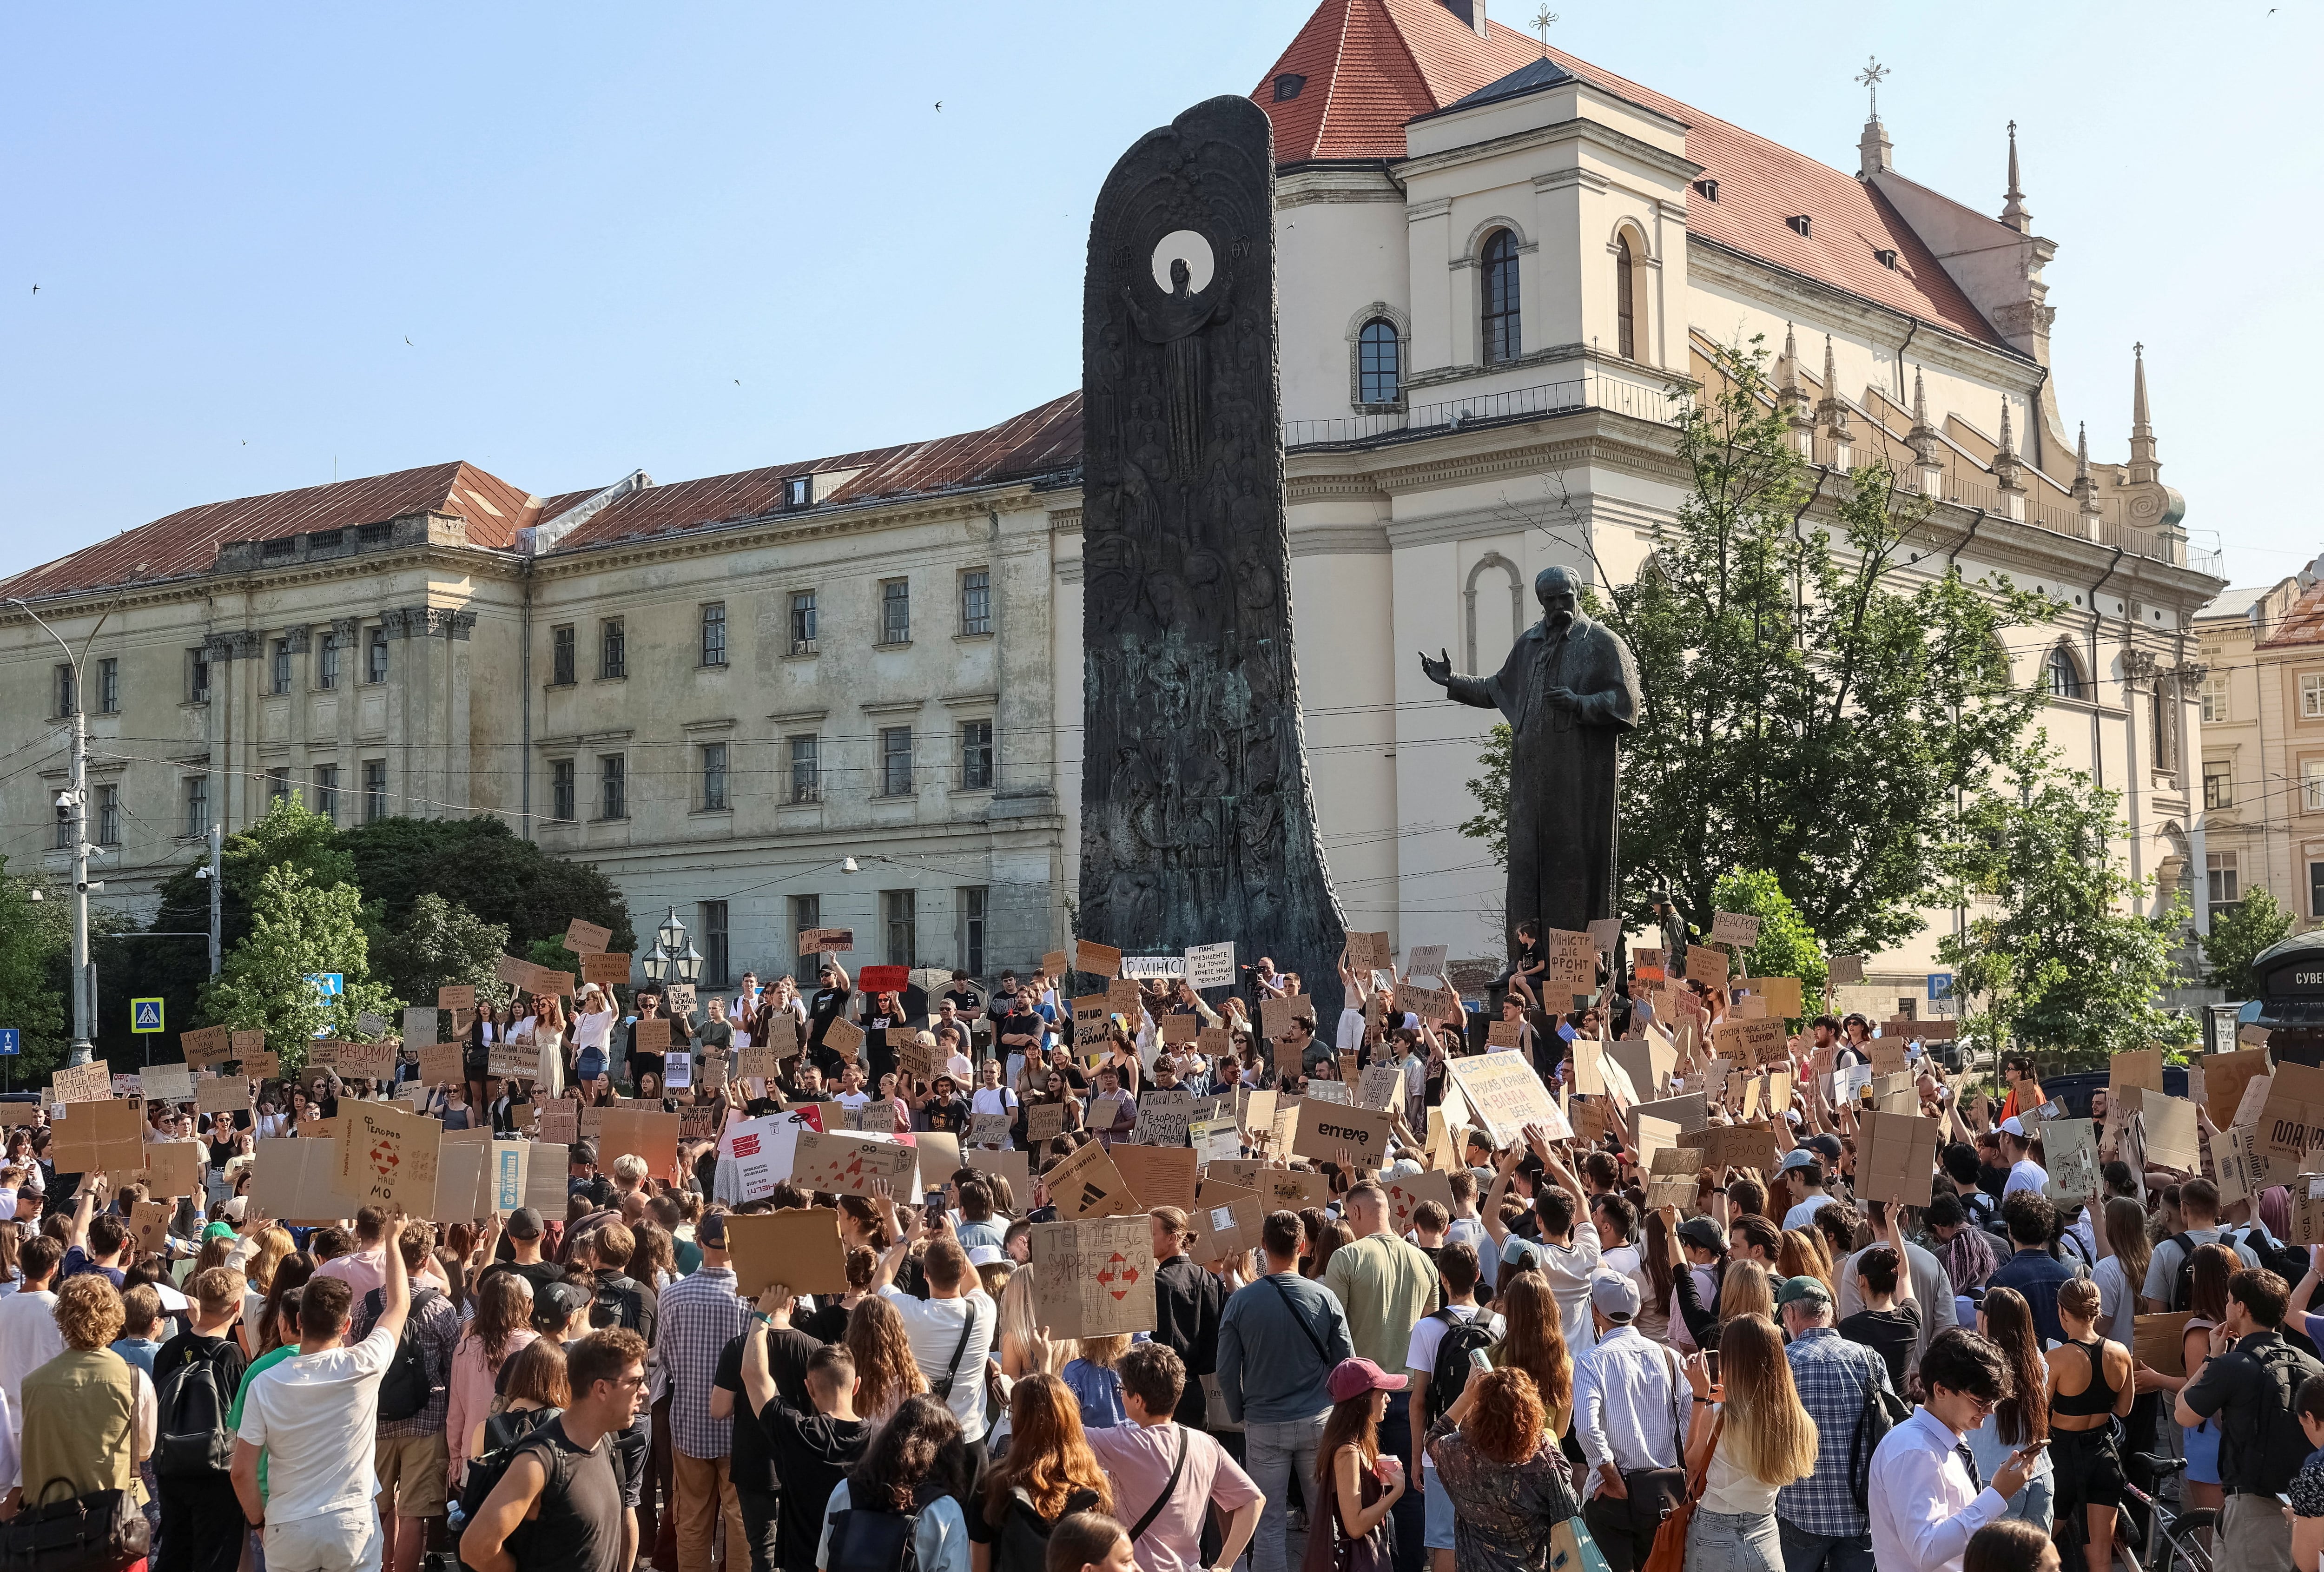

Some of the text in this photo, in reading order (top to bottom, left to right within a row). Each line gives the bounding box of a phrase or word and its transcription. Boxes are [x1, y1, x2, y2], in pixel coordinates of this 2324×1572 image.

[1374, 944, 1385, 955] НЕ
[1191, 951, 1229, 962] ПРЕЗИДЕНТЕ,
[1351, 955, 1379, 967] ПОРАДИВ
[1216, 965, 1233, 974] НАШОЇ
[1551, 957, 1589, 971] ФРОНТ
[1198, 973, 1230, 984] ПЕРЕМОГИ?
[1399, 984, 1430, 1000] РЕФОРМА
[1402, 996, 1445, 1017] МАЄ ЖИТИ
[362, 1013, 387, 1026] ФЕДОРОВ
[1078, 1008, 1102, 1021] ВИ ШО
[771, 1018, 793, 1033] БІГОМ
[835, 1018, 859, 1037] ПОКАЖІТЬ
[1075, 1026, 1093, 1038] ЙОБУ
[1494, 1023, 1519, 1034] ЕПОХА
[1884, 1024, 1921, 1037] ПОВЕРНІТЬ
[234, 1030, 262, 1046] СЕБЕ
[774, 1032, 794, 1044] ВЕРНУВ
[1720, 1026, 1740, 1040] РУСНЯ
[189, 1047, 214, 1056] МІНІСТР
[202, 1047, 228, 1057] ОБОРОНИ
[340, 1043, 392, 1062] РЕФОРМИ
[491, 1043, 518, 1054] ЗАГАЛЬНА
[739, 1048, 766, 1057] ФЕДОРОВ
[901, 1038, 928, 1059] ВЕРНІТЬ
[743, 1063, 764, 1074] НАДІЯ
[901, 1052, 931, 1076] ФЕДОРОВА
[54, 1066, 86, 1082] ЛИПЕНЬ
[513, 1066, 538, 1076] ФЕДОРОВ
[56, 1076, 87, 1091] МІСЯЦЬ
[1364, 1079, 1391, 1094] НАШОГО
[1172, 1093, 1184, 1105] ЗА
[1483, 1097, 1493, 1110] А
[863, 1119, 892, 1129] ЗАГИНЕМО
[1150, 1123, 1184, 1136] ПОЧАЛИ
[1722, 1127, 1743, 1140] ЦЕ
[1725, 1140, 1767, 1158] БУЛО
[744, 1168, 768, 1177] ВЕНТИЛЯТОР
[377, 1175, 395, 1185] НАШ
[746, 1178, 767, 1187] GFS-4010
[370, 1185, 391, 1199] МО
[1044, 1226, 1143, 1249] ТЕРПЕЦЬ
